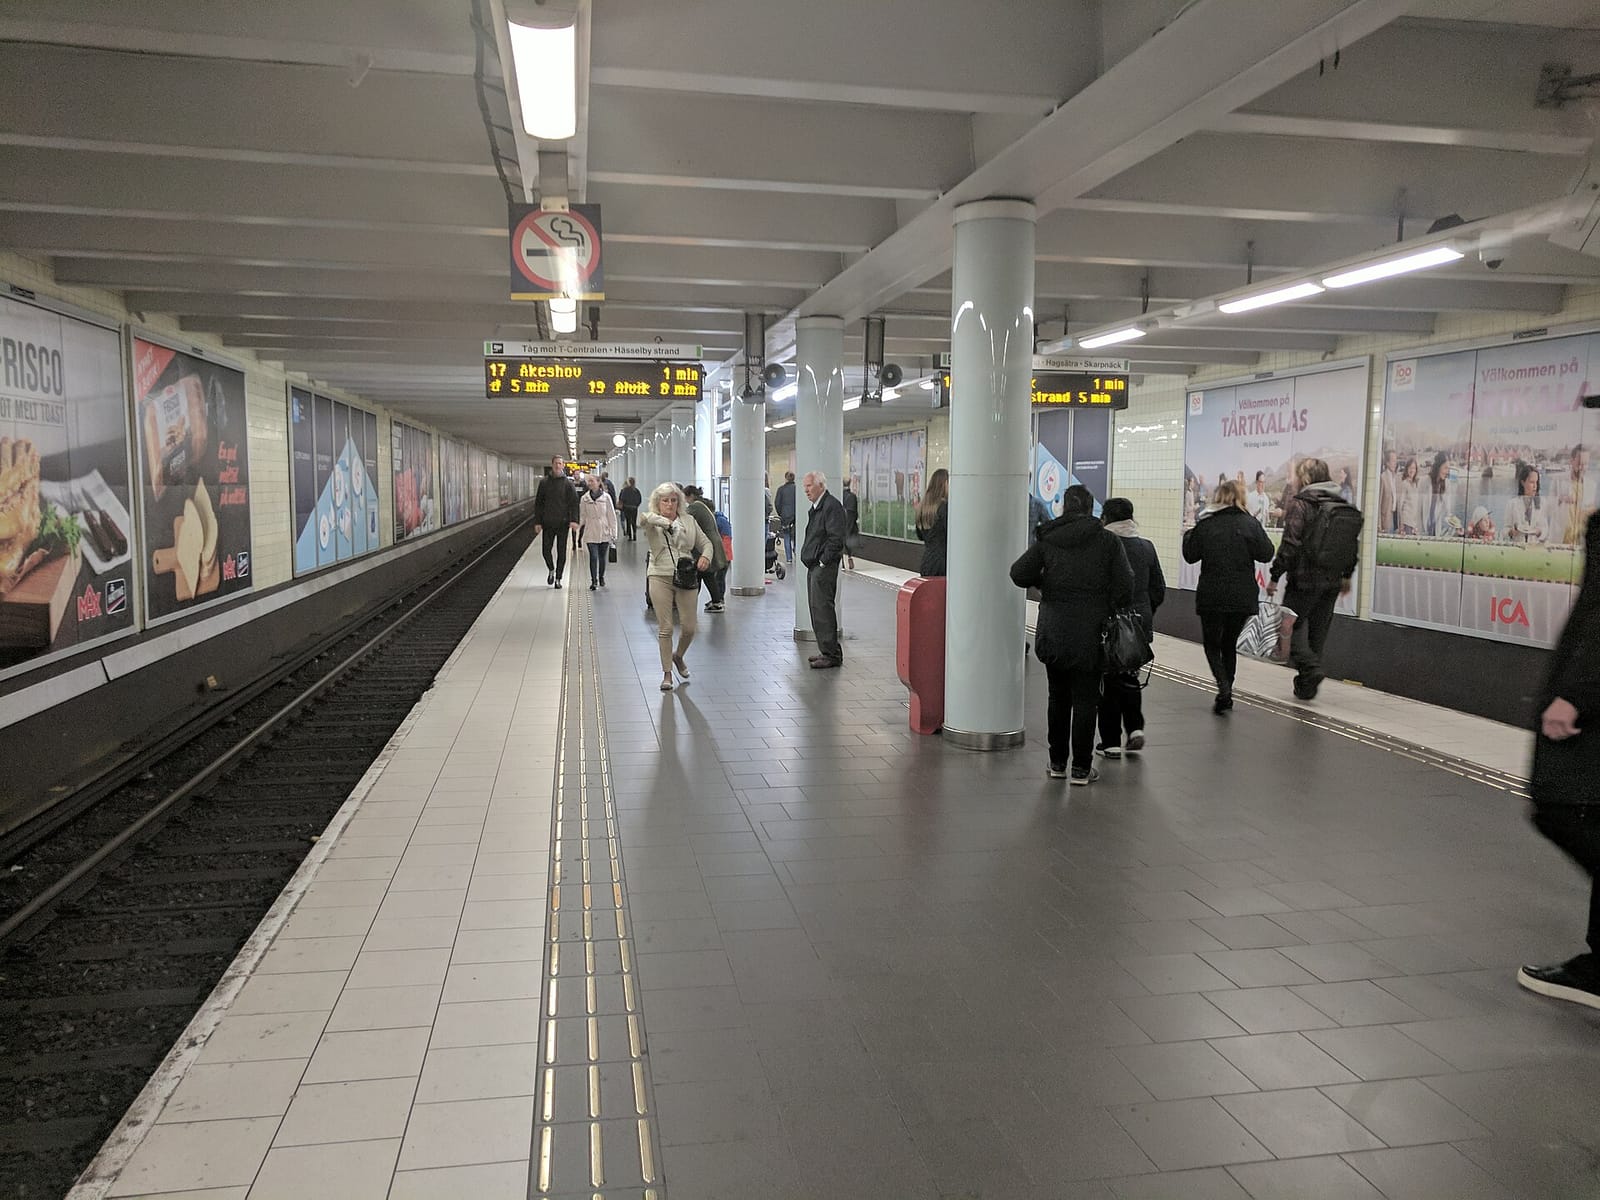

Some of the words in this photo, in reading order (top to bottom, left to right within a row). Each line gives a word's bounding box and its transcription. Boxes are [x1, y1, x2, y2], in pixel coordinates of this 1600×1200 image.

[559, 345, 608, 354] T-Centralen
[614, 346, 651, 356] Hässelby
[653, 347, 680, 355] strand
[0, 336, 63, 396] RISCO
[489, 362, 507, 377] 17
[663, 367, 670, 380] 1
[676, 367, 698, 381] min
[1481, 363, 1557, 383] Välkommen
[1560, 356, 1579, 378] på
[510, 379, 521, 392] 5
[524, 380, 550, 392] min
[588, 380, 606, 393] 19
[614, 381, 651, 395] Alvik
[673, 383, 697, 396] min
[1093, 378, 1100, 390] 1
[1104, 378, 1125, 391] min
[1078, 391, 1088, 403] 5
[1090, 392, 1112, 403] min
[1239, 396, 1279, 410] Välkommen
[1279, 393, 1290, 408] på
[15, 400, 38, 421] MELT
[1221, 408, 1308, 438] TÅRTKALAS
[77, 584, 102, 621] MAX
[1490, 596, 1530, 627] ICA
